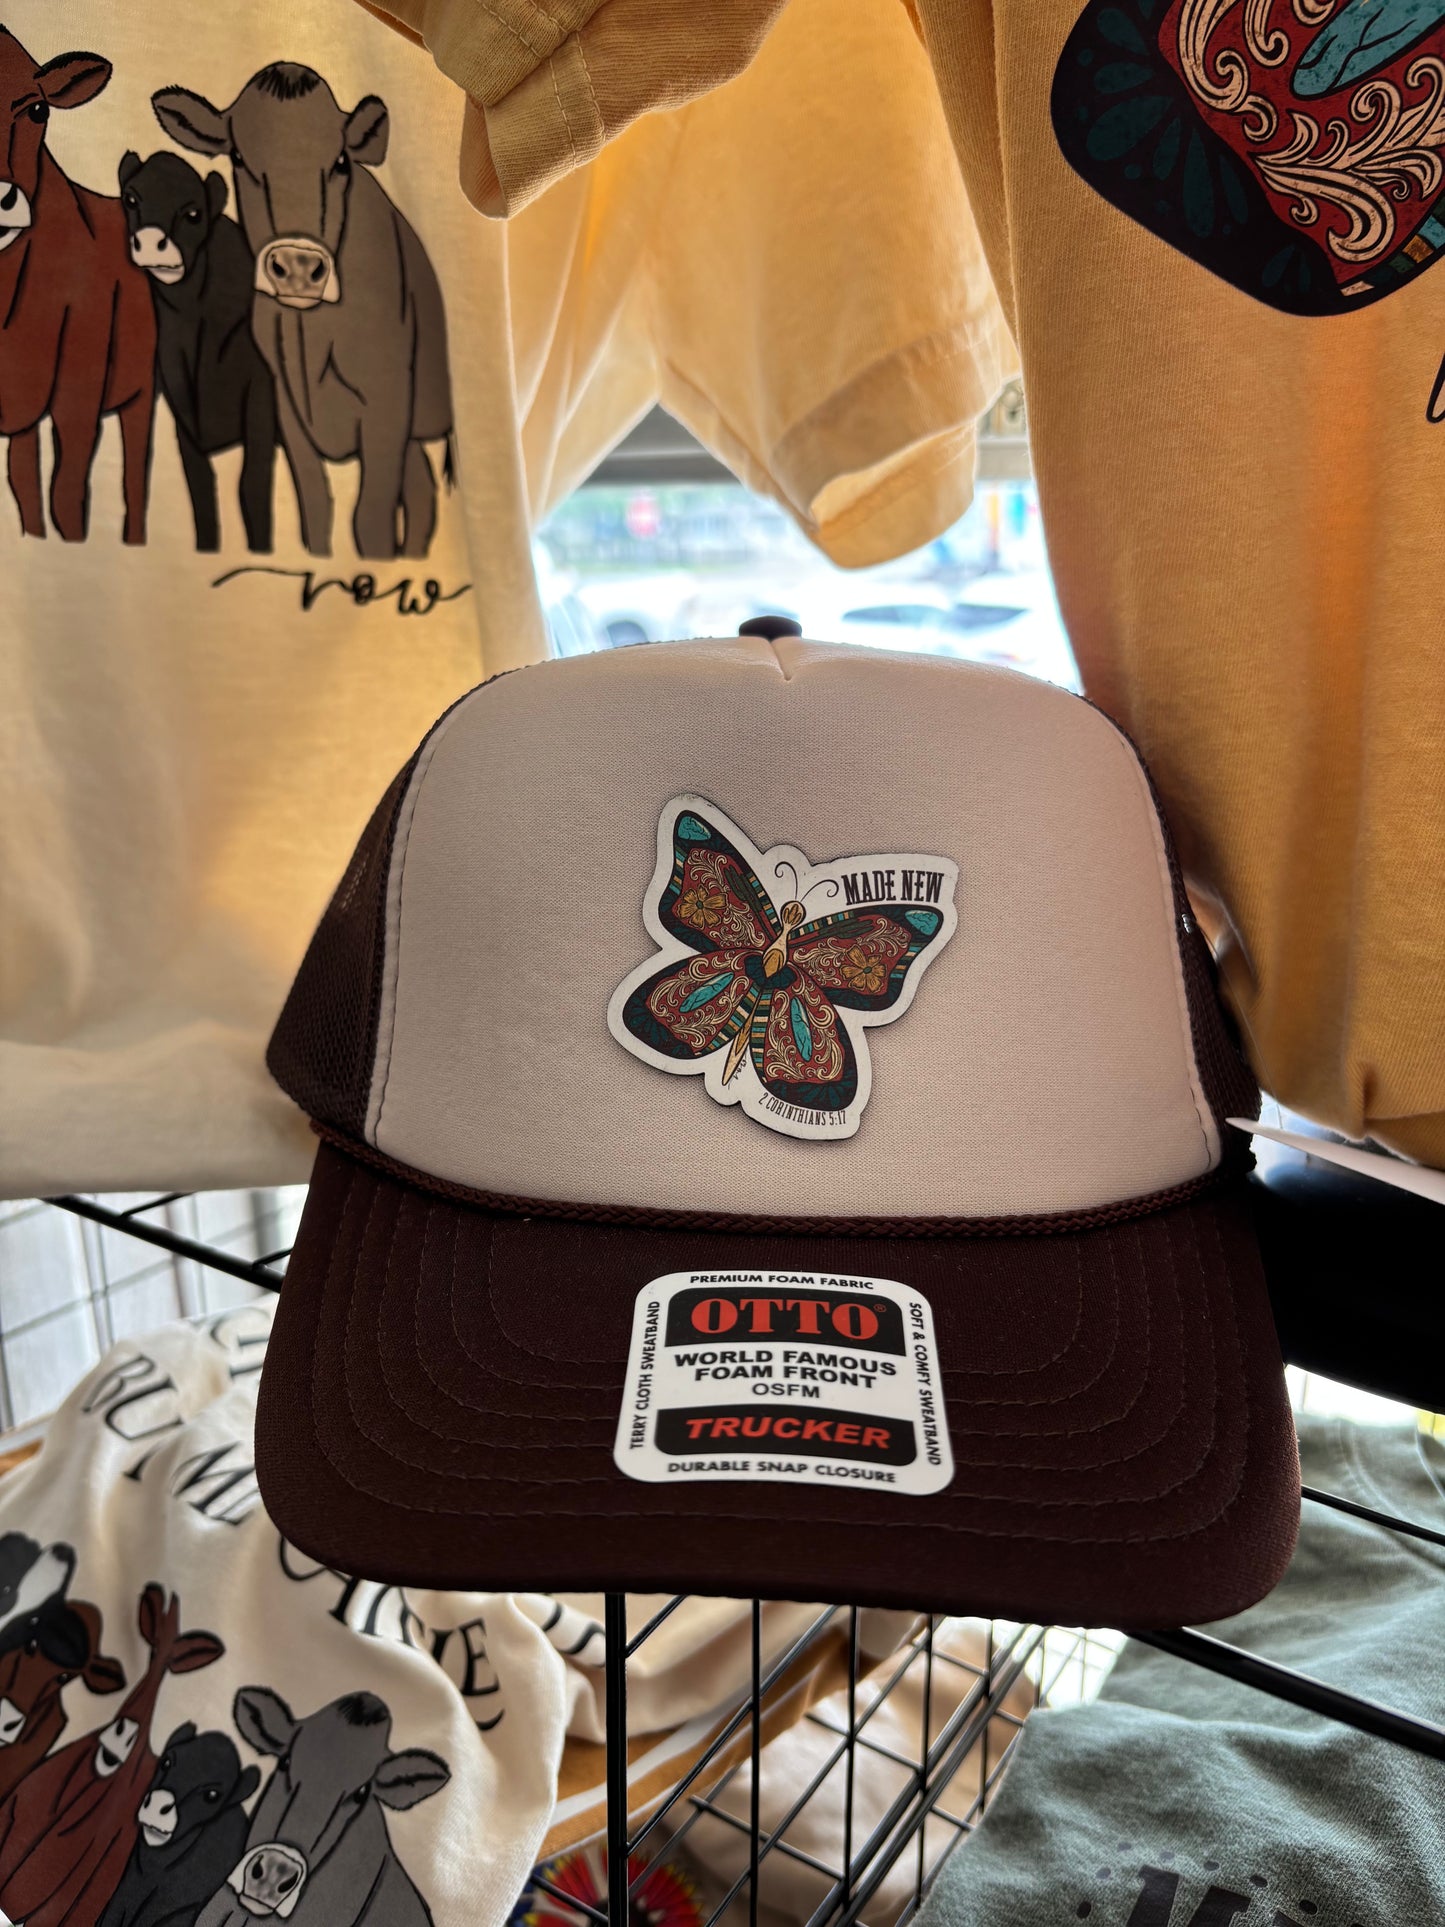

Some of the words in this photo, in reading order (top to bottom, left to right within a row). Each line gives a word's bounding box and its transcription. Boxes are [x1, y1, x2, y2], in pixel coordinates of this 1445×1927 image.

[841, 869, 896, 905] MADE
[900, 869, 944, 903] NEW
[758, 1092, 769, 1105] 2
[765, 1096, 826, 1126] CORINTHIANS
[829, 1110, 846, 1126] 5:17
[690, 1274, 763, 1283] PREMIUM
[768, 1275, 815, 1284] FOAM
[820, 1278, 874, 1290] FABRIC
[909, 1302, 924, 1330] SOFT
[641, 1301, 660, 1370] SWEATBAND
[912, 1331, 925, 1341] &
[674, 1350, 774, 1367] WORLD
[783, 1351, 897, 1376] FAMOUS
[695, 1365, 773, 1381] FOAM
[783, 1366, 877, 1388] FRONT
[914, 1344, 932, 1387] COMFY
[635, 1373, 652, 1411] CLOTH
[752, 1383, 820, 1398] OSFM
[629, 1414, 647, 1450] TERRY
[685, 1416, 892, 1449] TRUCKER
[919, 1389, 942, 1466] SWEATBAND
[668, 1461, 750, 1473] DURABLE
[757, 1461, 808, 1473] SNAP
[815, 1465, 896, 1483] CLOSURE
